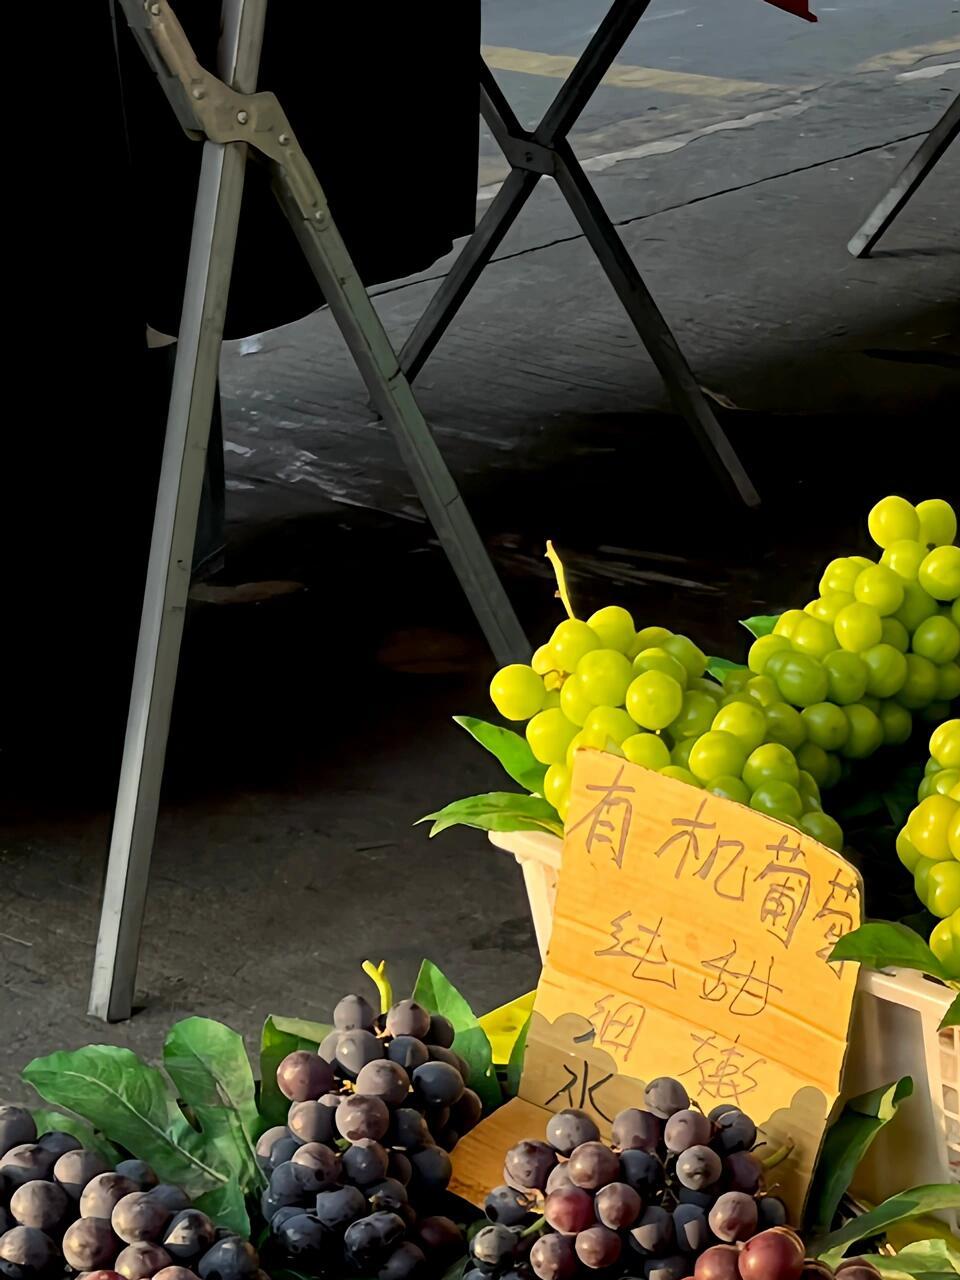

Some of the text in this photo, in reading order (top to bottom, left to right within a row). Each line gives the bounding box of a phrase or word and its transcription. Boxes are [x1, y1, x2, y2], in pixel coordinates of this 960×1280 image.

[566, 765, 859, 979] 有机葡萄
[594, 911, 783, 1016] 纯甜
